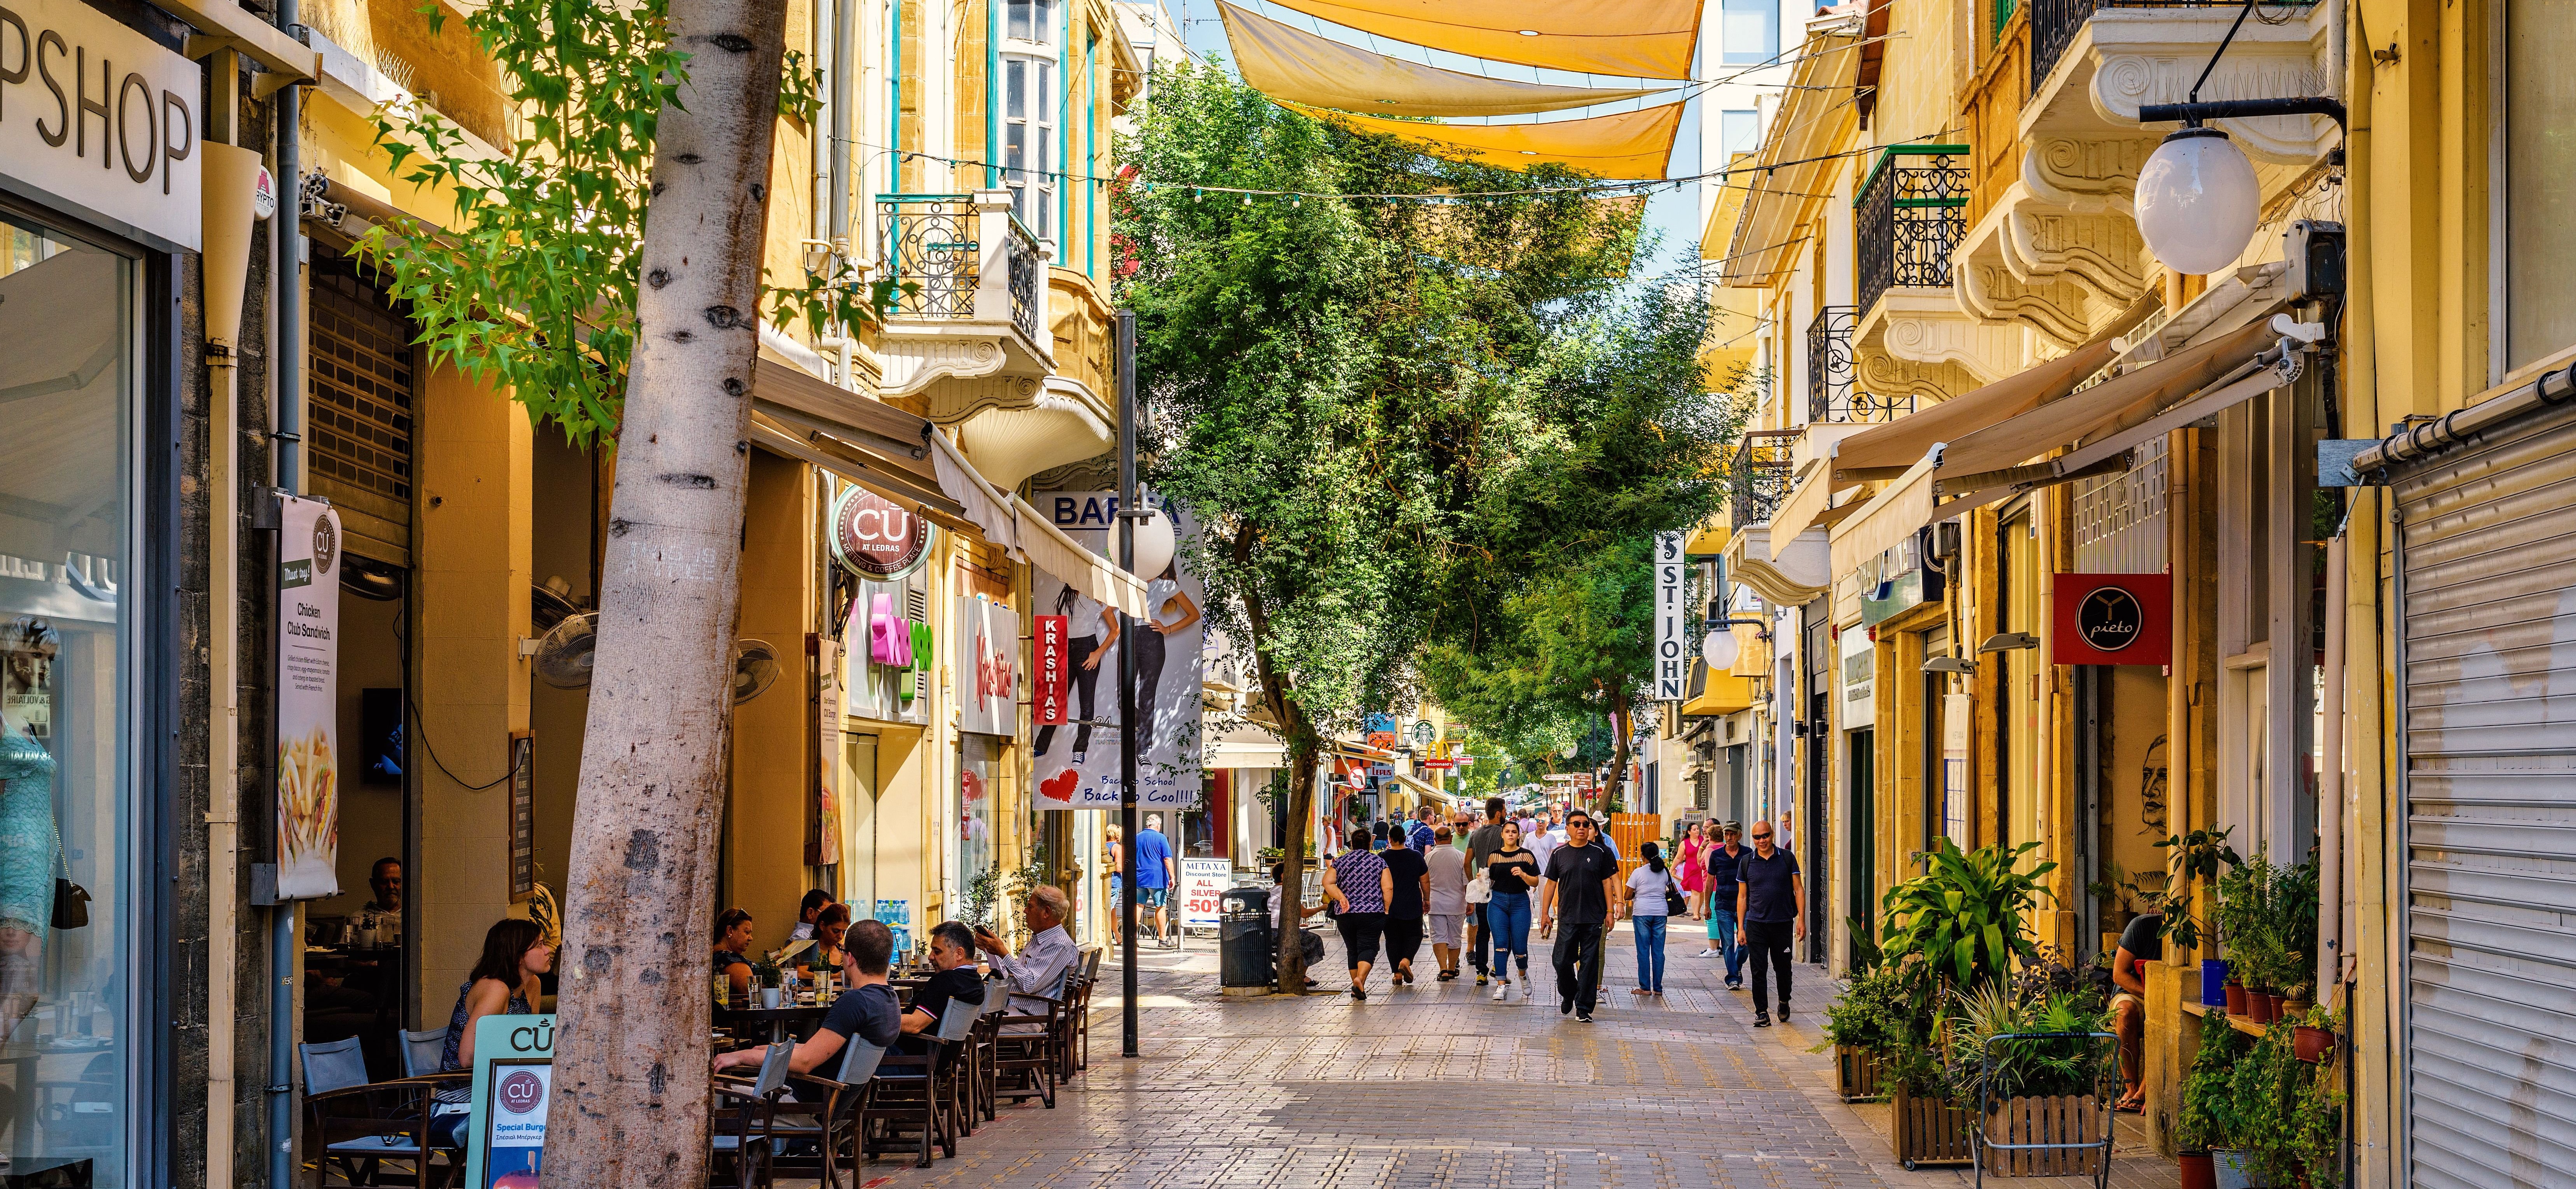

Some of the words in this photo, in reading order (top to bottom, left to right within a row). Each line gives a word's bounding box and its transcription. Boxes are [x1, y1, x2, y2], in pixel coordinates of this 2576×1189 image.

[257, 191, 274, 208] RYPTO
[1055, 497, 1181, 525] BAA
[842, 543, 866, 568] MEETING
[875, 563, 903, 573] COFFEE
[903, 546, 921, 566] PLACE
[284, 568, 298, 581] Must
[299, 565, 310, 582] try!
[298, 602, 320, 619] Chicken
[287, 621, 301, 636] Club
[302, 623, 330, 640] Sandwich
[2091, 621, 2133, 638] pieto
[1661, 616, 1679, 698] JOHN
[1045, 620, 1057, 720] KRASHIAS
[1372, 767, 1391, 776] LEPUS
[1102, 775, 1122, 784] Bac
[1146, 777, 1175, 786] School
[1084, 789, 1118, 801] Back
[2146, 905, 2163, 914] Ιδιω
[502, 1099, 513, 1111] MEETING
[530, 1098, 539, 1109] PLACE
[497, 1124, 523, 1132] Special
[525, 1123, 546, 1132] Burg
